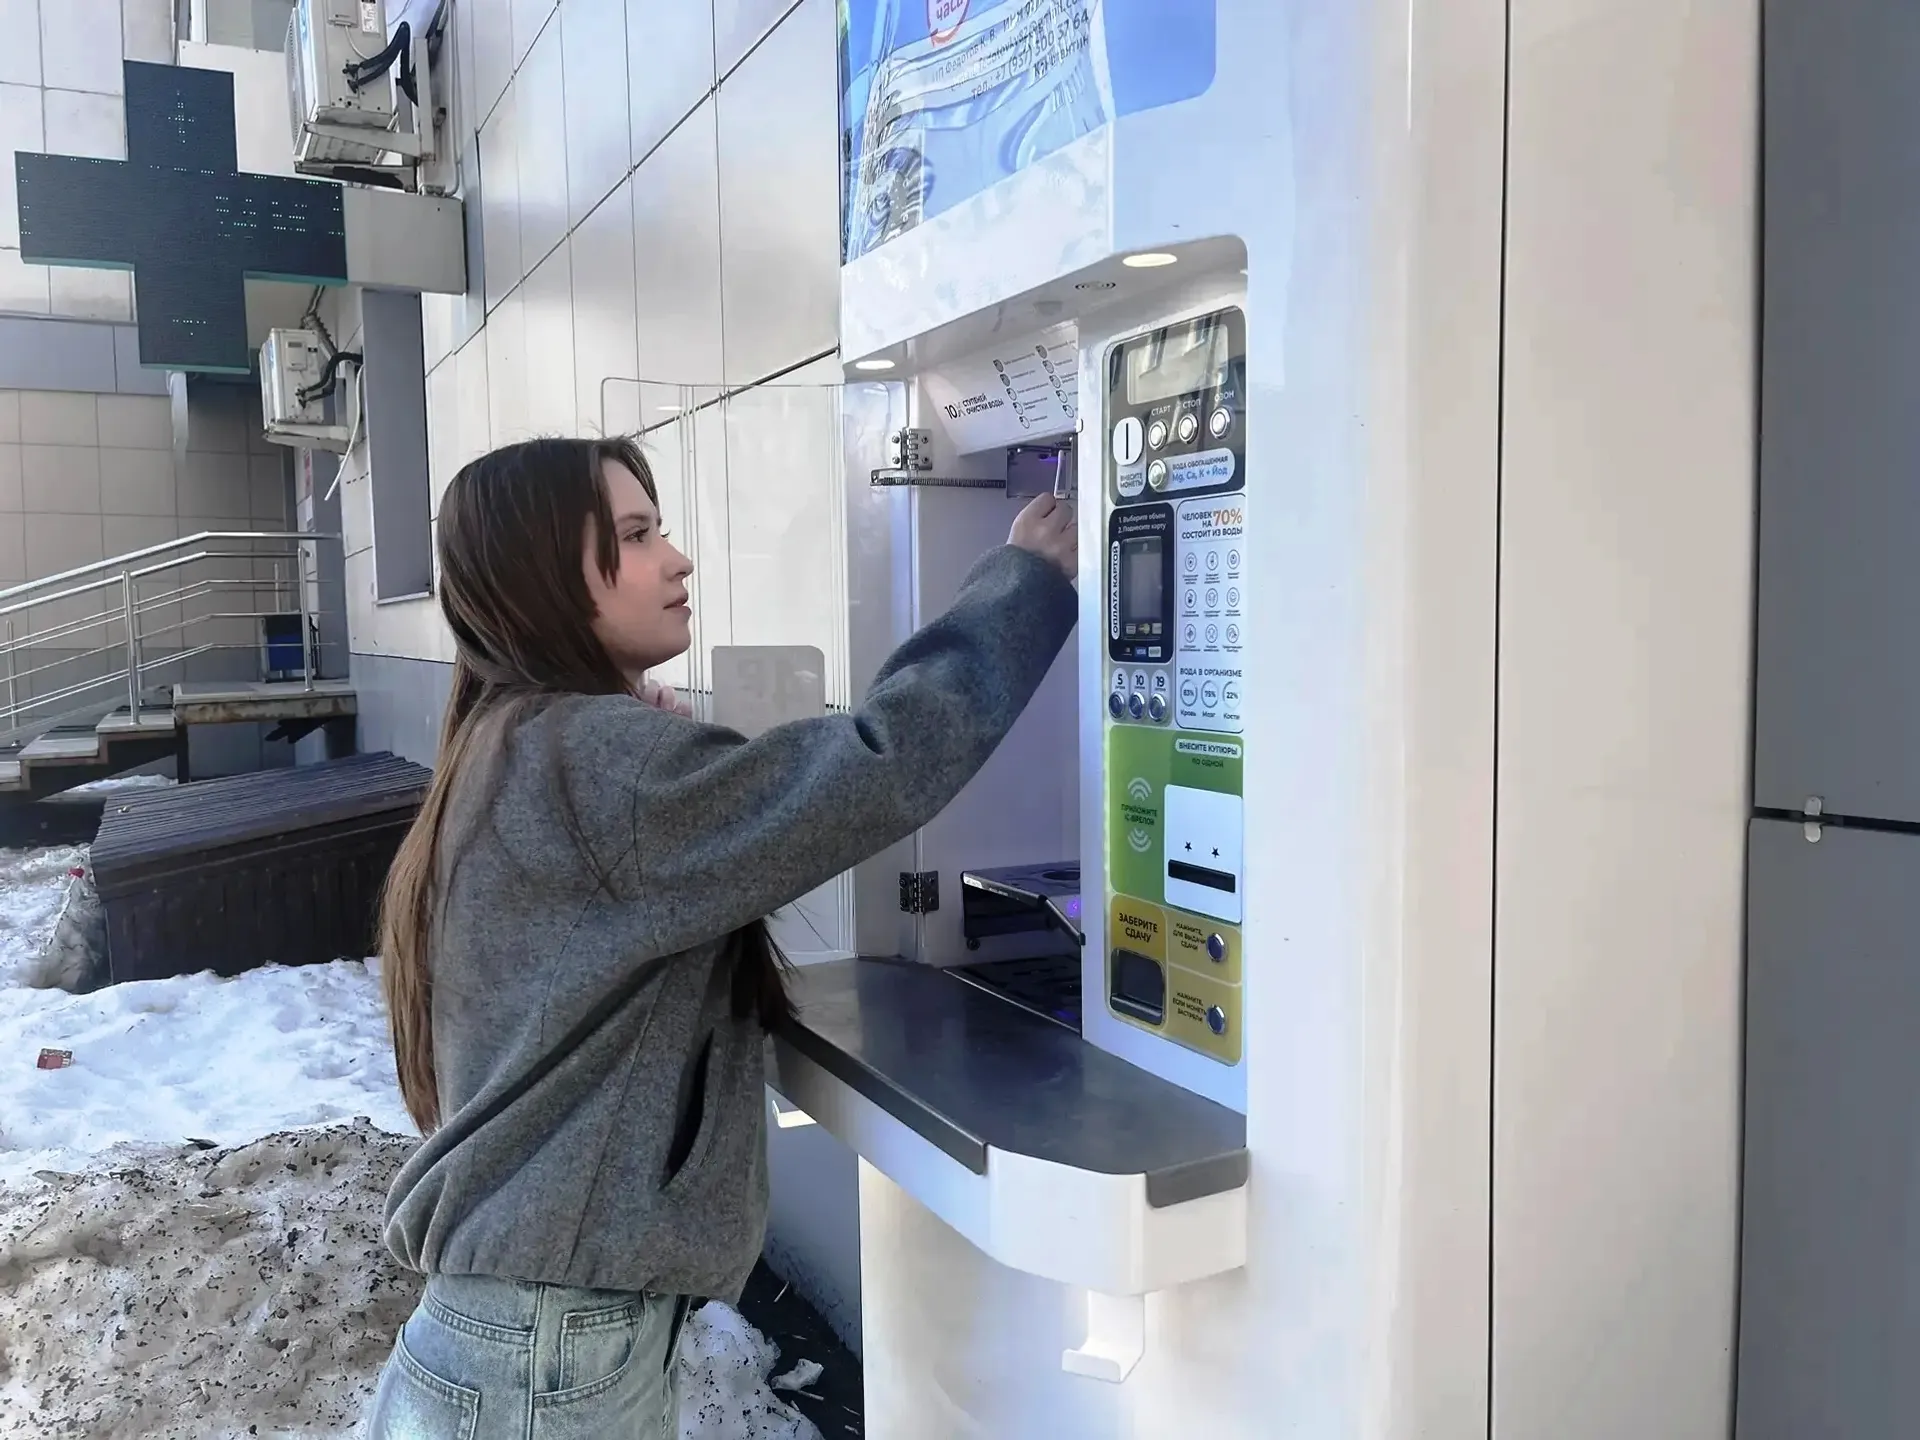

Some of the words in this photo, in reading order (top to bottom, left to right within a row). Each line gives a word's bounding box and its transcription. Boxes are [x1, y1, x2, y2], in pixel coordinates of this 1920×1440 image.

[1073, 8, 1089, 31] 64
[1214, 390, 1235, 402] ОЗОН
[1182, 398, 1201, 410] СТОП
[944, 404, 957, 419] 10
[1151, 405, 1171, 416] СТАРТ
[1172, 461, 1188, 470] ВОДА
[1188, 455, 1229, 468] ОБОГАЩЕННАЯ
[1212, 465, 1228, 475] Йод
[1121, 472, 1143, 481] ВНЕСИТЕ
[1120, 480, 1143, 489] МОНЕТЫ
[1123, 514, 1148, 523] Выберите
[1149, 512, 1166, 520] объем
[1181, 511, 1212, 521] ЧЕЛОВЕК
[1212, 508, 1242, 526] 70%
[1123, 524, 1150, 532] Поднесите
[1151, 523, 1167, 531] карту
[1202, 520, 1212, 528] НА
[1181, 530, 1211, 540] СОСТОИТ
[1212, 529, 1221, 537] ИЗ
[1222, 526, 1242, 536] ВОДЫ
[1180, 667, 1197, 676] ВОДА
[1198, 668, 1203, 676] В
[1204, 668, 1242, 677] ОРГАНИЗМЕ
[1117, 673, 1123, 685] 5
[1135, 674, 1144, 686] 10
[1155, 676, 1165, 687] 19
[1226, 691, 1239, 699] 22%
[1180, 709, 1197, 717] Кровь
[1202, 710, 1216, 718] Мозг
[1223, 712, 1240, 720] Кости
[1178, 742, 1207, 752] ВНЕСИТЕ
[1207, 745, 1237, 755] КУПЮРЫ
[1201, 758, 1223, 768] ОДНОЙ
[1121, 803, 1157, 817] ПРИЛОЖИТЕ
[1119, 912, 1158, 933] ЗАБЕРИТЕ
[1125, 927, 1151, 943] СДАЧУ
[1173, 929, 1184, 938] ДЛЯ
[1181, 940, 1198, 950] СДАЧИ
[1172, 997, 1185, 1007] ЕСЛИ
